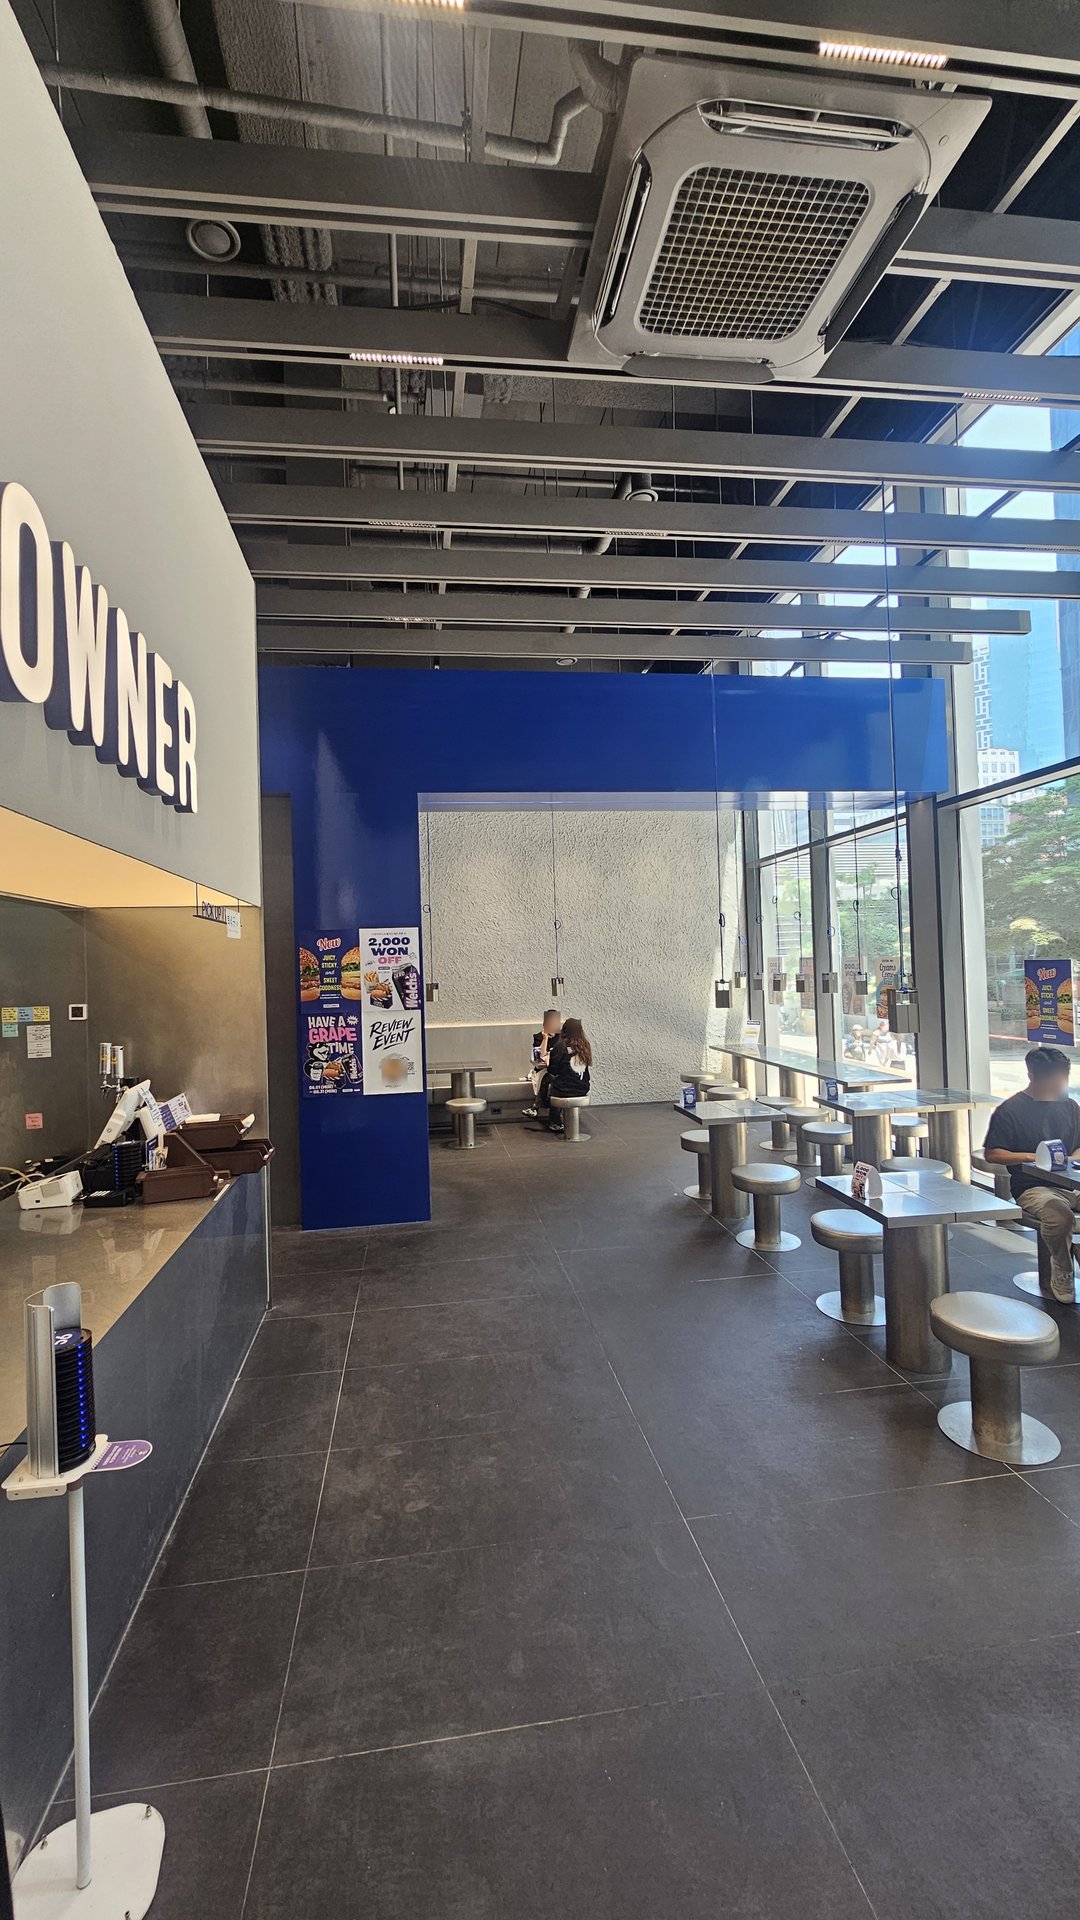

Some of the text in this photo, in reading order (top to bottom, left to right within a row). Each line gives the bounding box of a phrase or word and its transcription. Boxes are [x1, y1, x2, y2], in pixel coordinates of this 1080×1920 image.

[0, 481, 198, 814] OWNER
[317, 938, 341, 951] New
[368, 937, 411, 947] 2,000
[371, 947, 408, 956] WON
[378, 956, 402, 964] OFF
[1037, 968, 1056, 981] New
[405, 972, 418, 1008] Welch's
[307, 1015, 346, 1028] HAVE A
[369, 1017, 414, 1038] REVIEW
[308, 1027, 357, 1044] GRAPE
[372, 1027, 416, 1051] EVENT
[326, 1041, 354, 1054] TIME
